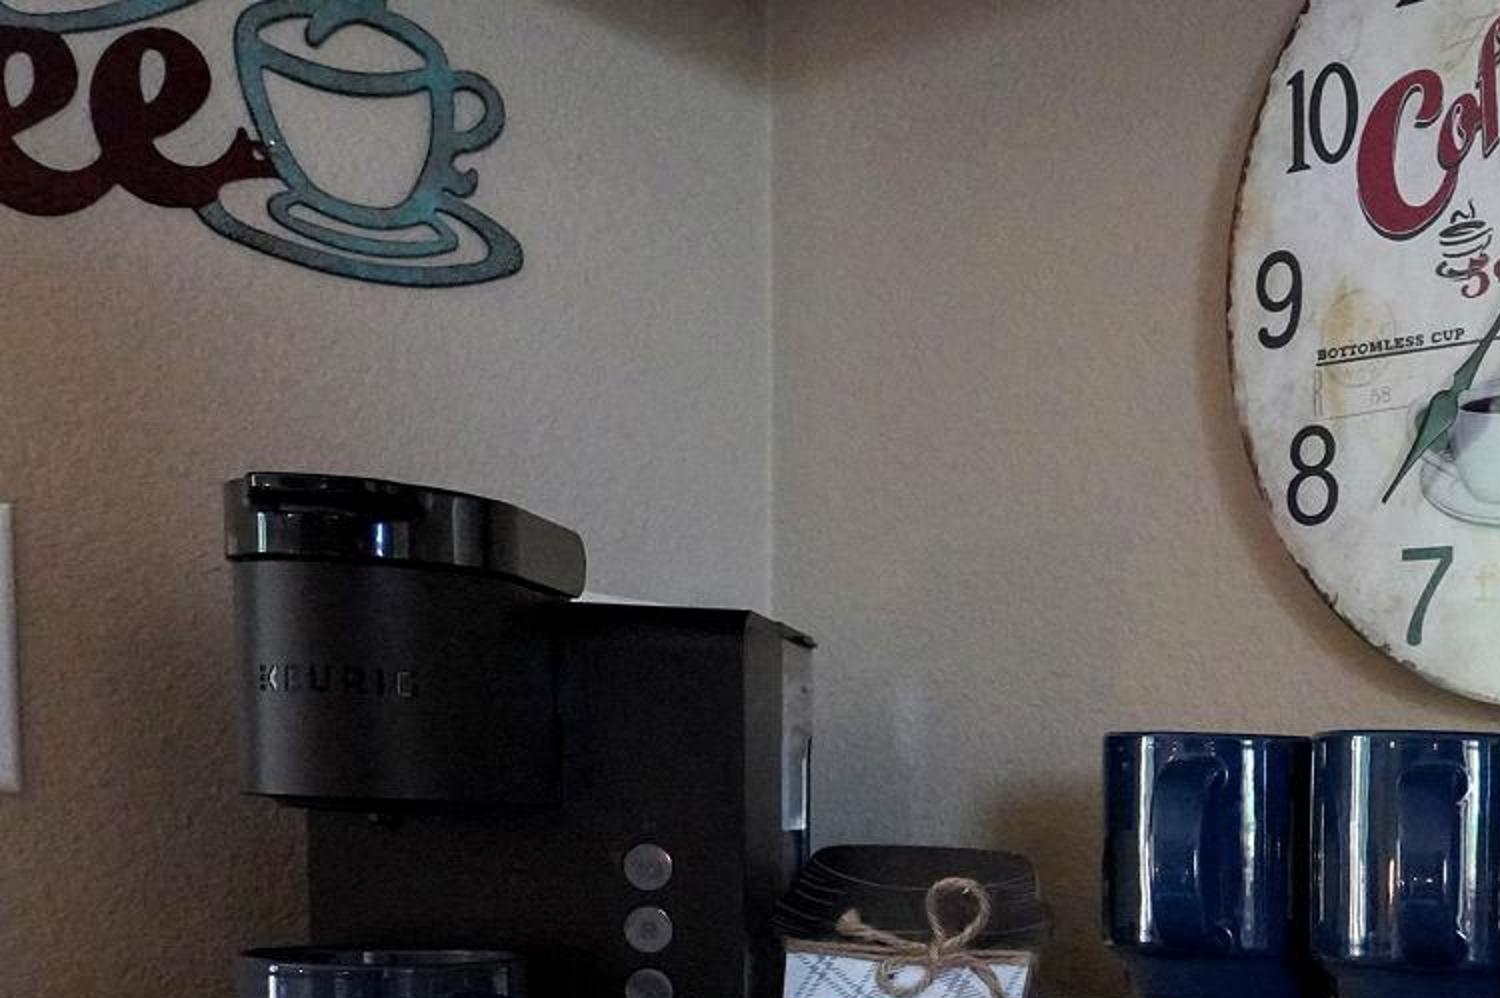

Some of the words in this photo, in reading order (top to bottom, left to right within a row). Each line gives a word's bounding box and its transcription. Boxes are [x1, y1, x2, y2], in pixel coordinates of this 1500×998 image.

[1286, 61, 1359, 176] 10
[1255, 250, 1304, 350] 9
[1316, 333, 1425, 362] BOTTOMLESS
[1430, 326, 1466, 344] CUP
[1286, 425, 1338, 527] 8
[1400, 545, 1454, 647] 7
